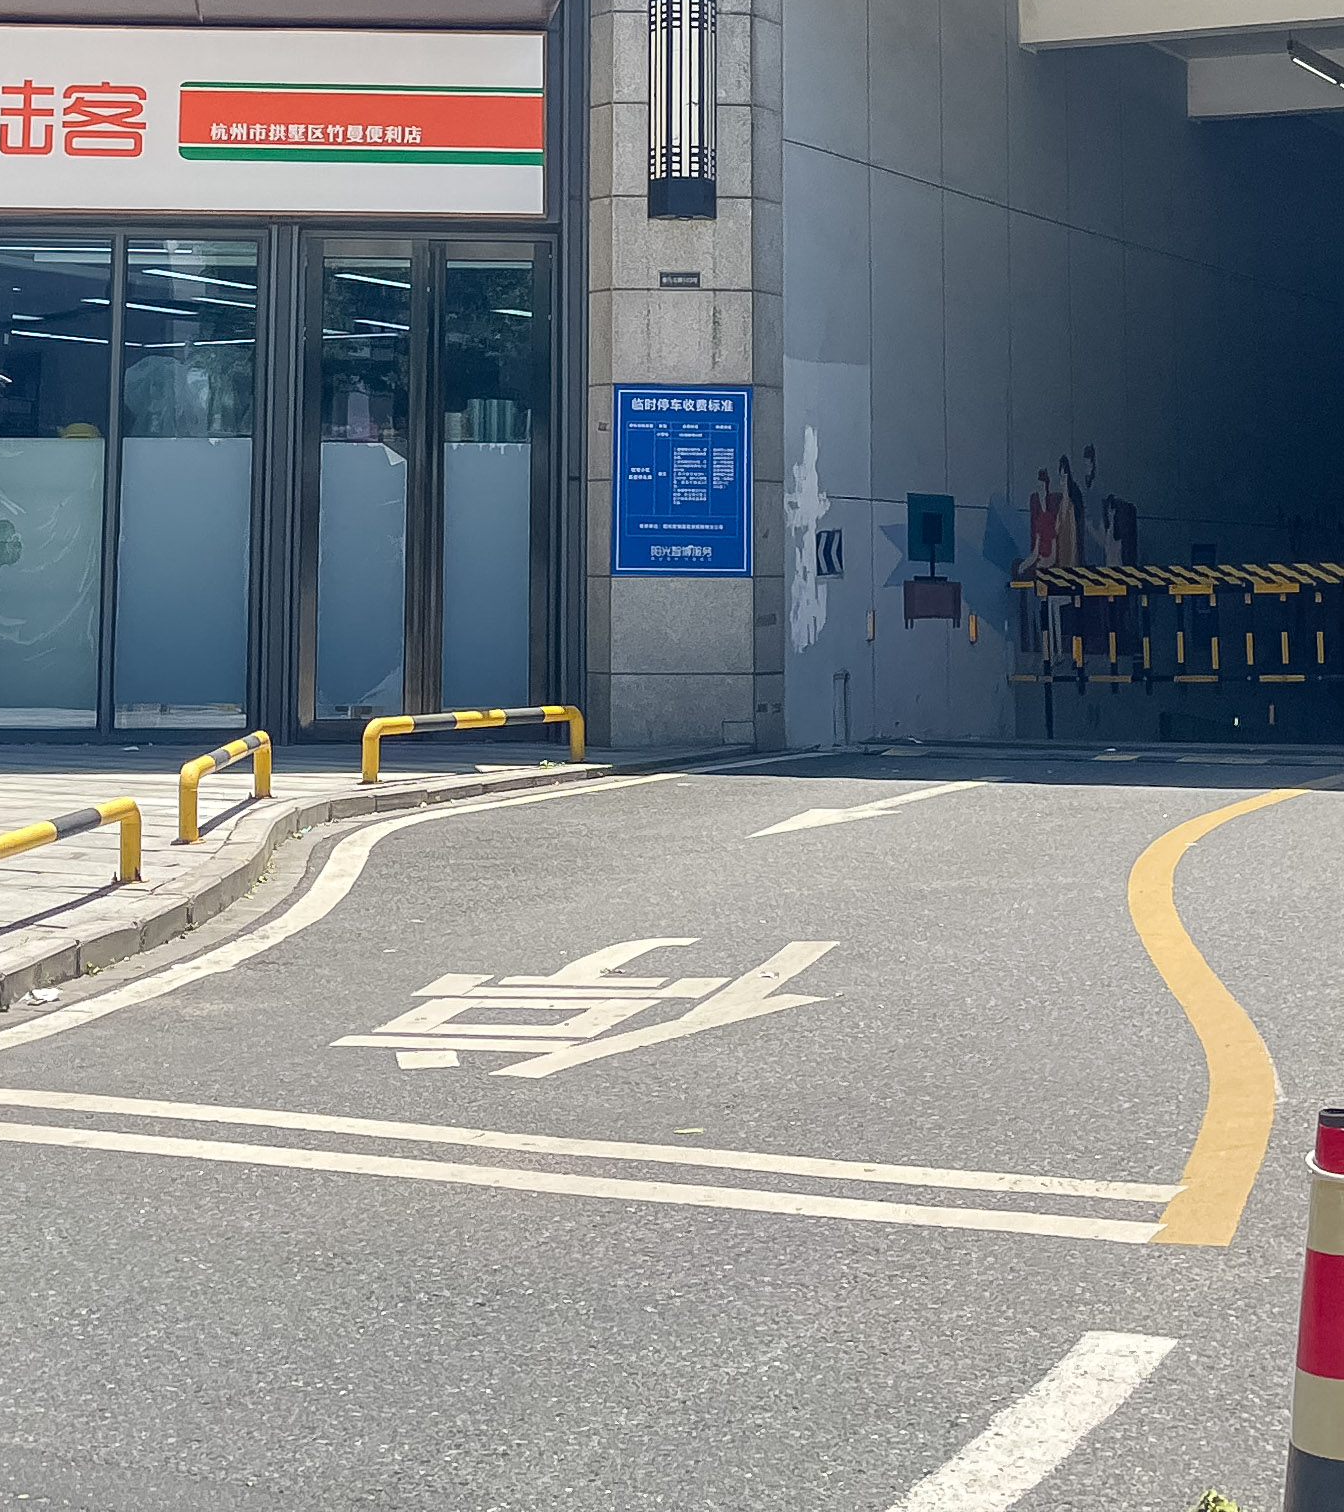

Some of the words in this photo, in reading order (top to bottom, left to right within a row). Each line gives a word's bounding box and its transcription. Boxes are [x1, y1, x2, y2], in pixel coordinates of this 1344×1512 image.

[209, 122, 423, 144] 杭州市拱墅区竹曼便利店
[631, 397, 734, 412] 临时停车收费标准
